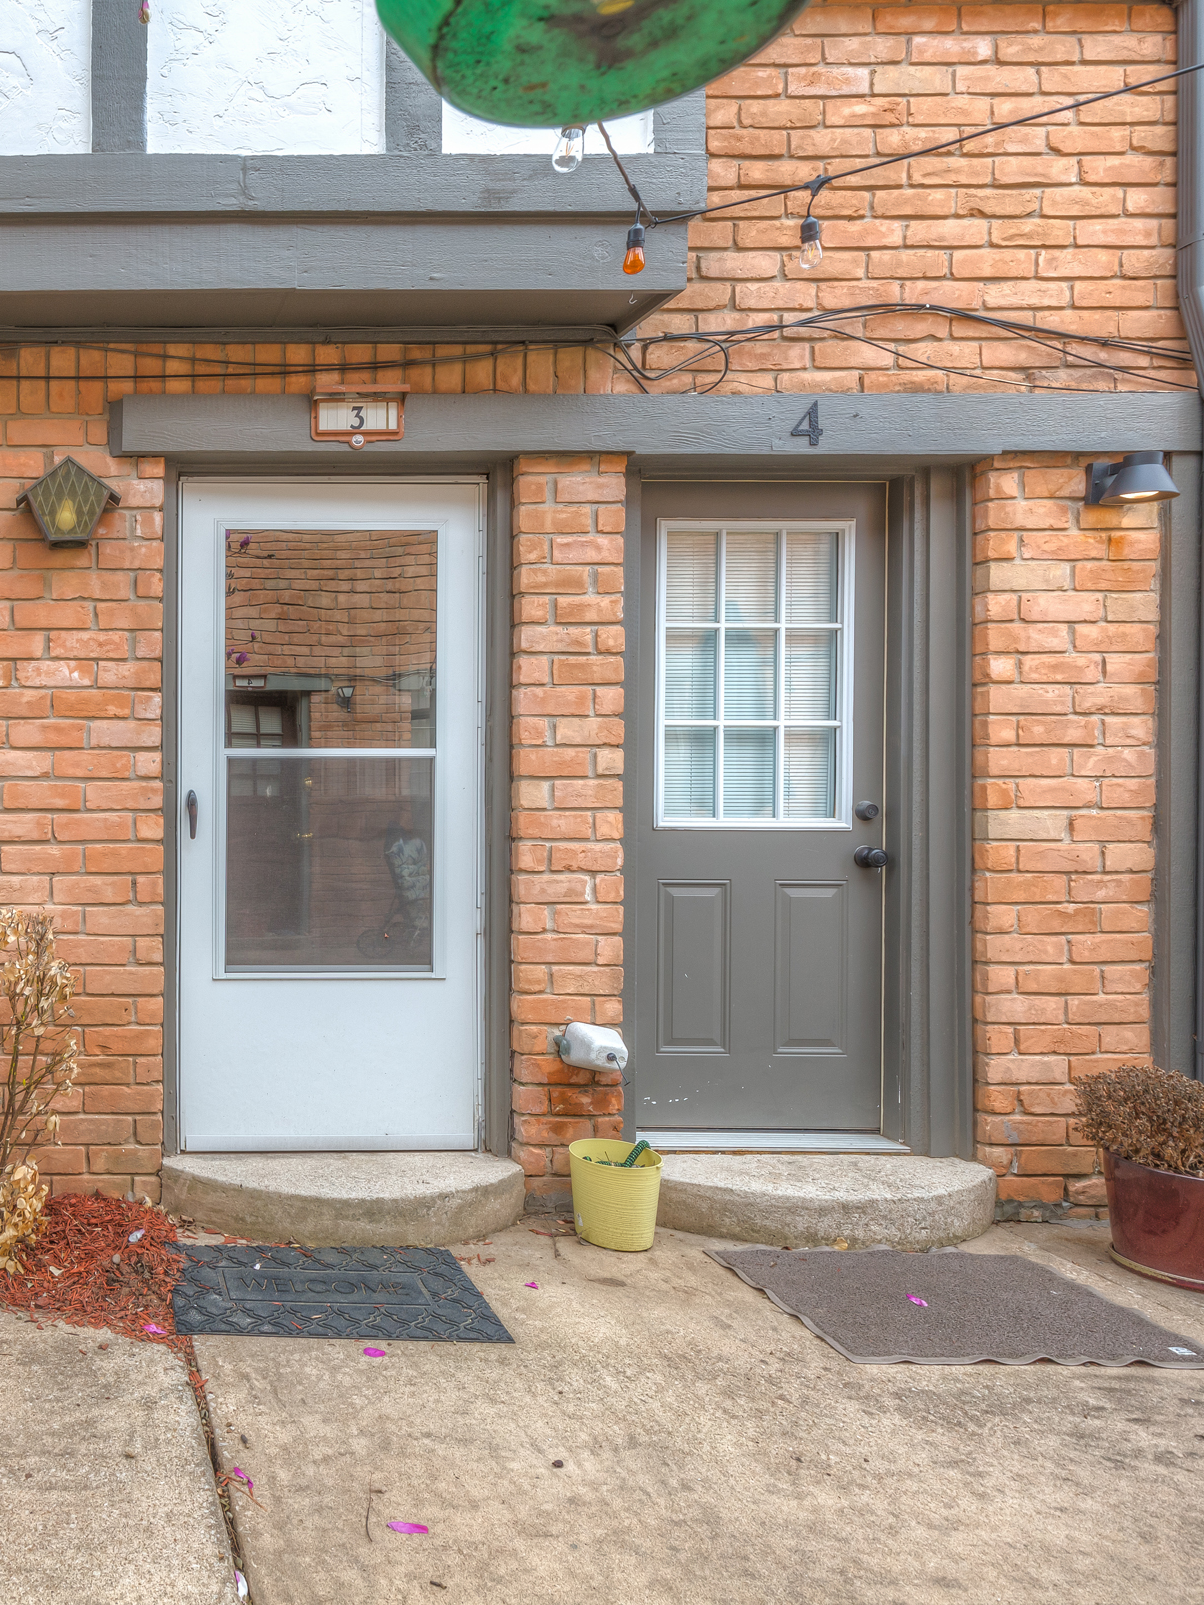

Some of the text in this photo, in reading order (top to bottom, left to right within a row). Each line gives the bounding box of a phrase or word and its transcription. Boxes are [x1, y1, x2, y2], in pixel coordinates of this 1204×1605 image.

[350, 406, 364, 430] 3
[791, 400, 823, 445] 4
[240, 1277, 410, 1296] WELCOME
